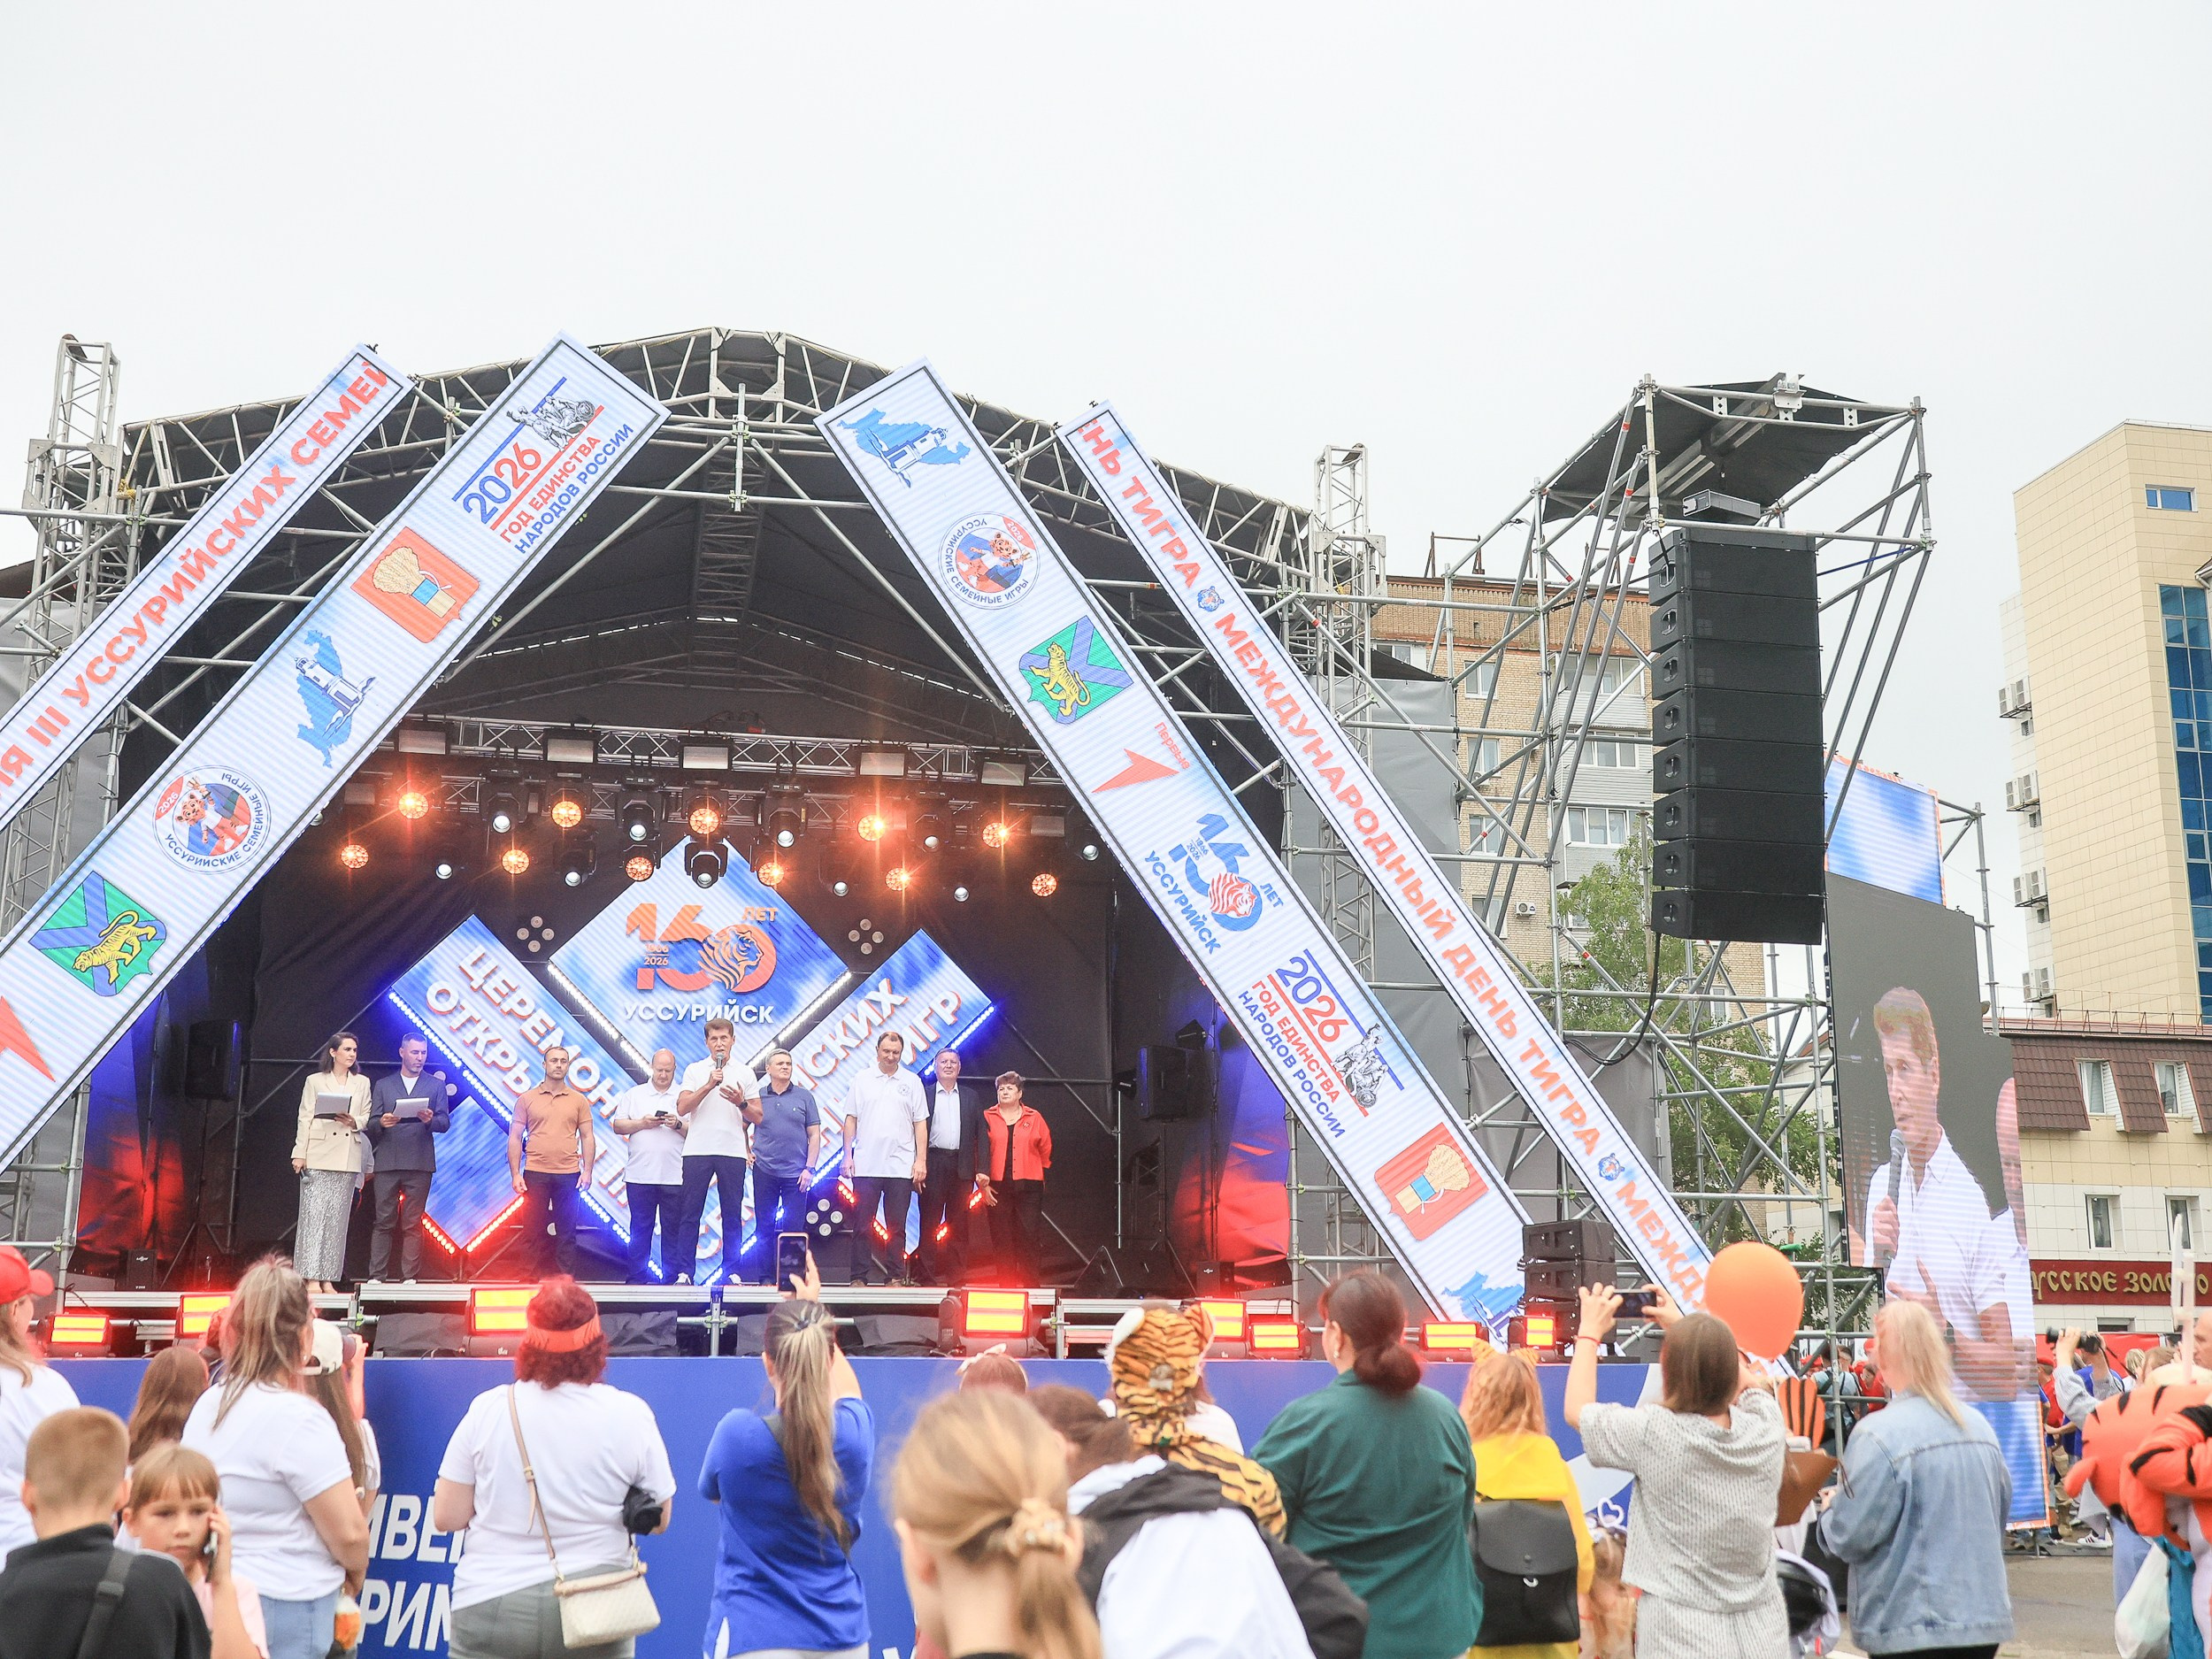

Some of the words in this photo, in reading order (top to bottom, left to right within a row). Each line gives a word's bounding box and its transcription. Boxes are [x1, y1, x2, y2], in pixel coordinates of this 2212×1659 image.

[463, 442, 541, 525] 2026
[500, 511, 534, 542] ГОД
[528, 435, 601, 511] ЕДИНСТВА
[514, 483, 580, 554] НАРОДОВ
[577, 423, 634, 485] РОССИИ
[945, 518, 987, 573] УССУРИЙСКИЕ
[1007, 521, 1024, 541] 2026
[26, 705, 70, 748] III
[61, 464, 296, 708] УССУРИЙСКИХ
[950, 576, 1002, 604] СЕМЕЙНЫЕ
[1004, 579, 1029, 601] ИГРЫ
[1154, 722, 1190, 769] Первые
[221, 772, 252, 795] ИГРЫ
[157, 791, 179, 813] 2026
[242, 793, 264, 853] СЕМЕЙНЫЕ
[165, 833, 242, 867] УССУРИЙСКИЕ
[1187, 842, 1202, 861] 2026
[1194, 838, 1210, 856] 1866
[1121, 475, 1201, 588] ТИГРА
[1214, 612, 1456, 941] МЕЖДУНАРОДНЫЙ
[1441, 943, 1519, 1040] ДЕНЬ
[1519, 1038, 1602, 1156] ТИГРА
[1616, 1180, 1706, 1310] МЕЖД
[1145, 850, 1221, 955] УССУРИЙСК
[1260, 882, 1283, 909] ЛЕТ
[741, 906, 779, 922] ЛЕТ
[644, 956, 669, 966] 2026
[624, 998, 774, 1024] УССУРИЙСК
[1275, 956, 1349, 1042] 2026
[1252, 980, 1280, 1017] ГОД
[1277, 1016, 1340, 1103] ЕДИНСТВА
[1238, 990, 1297, 1069] НАРОДОВ
[1292, 1069, 1346, 1139] РОССИИ
[2124, 1271, 2208, 1295] ЗОЛОО
